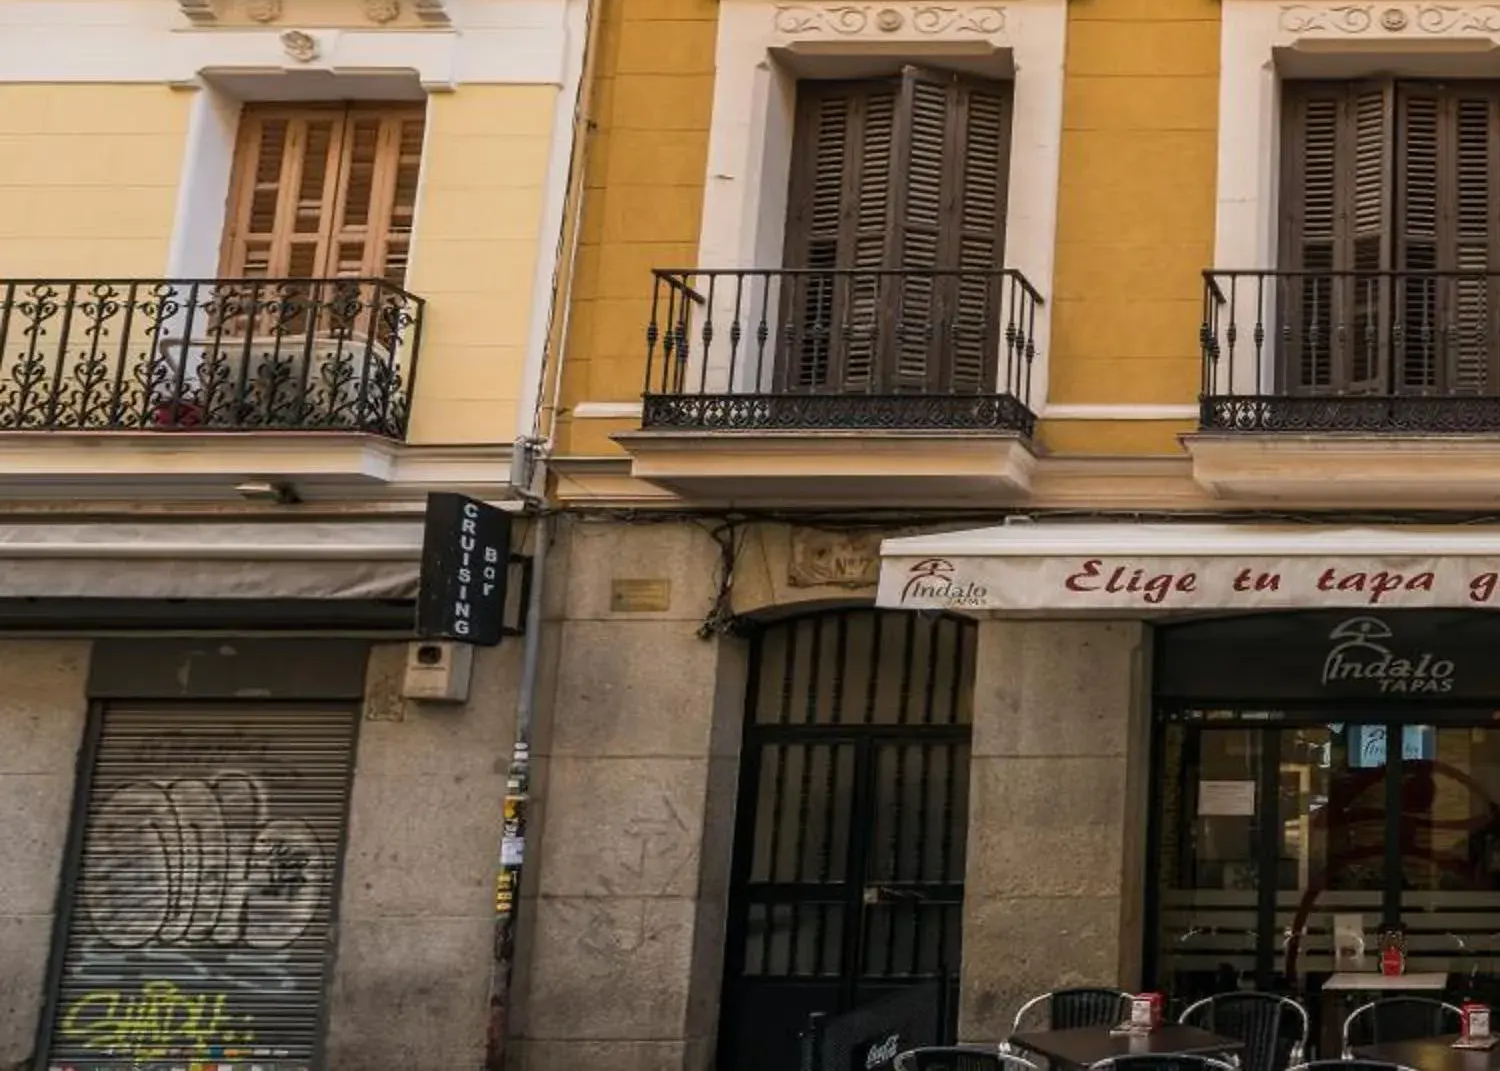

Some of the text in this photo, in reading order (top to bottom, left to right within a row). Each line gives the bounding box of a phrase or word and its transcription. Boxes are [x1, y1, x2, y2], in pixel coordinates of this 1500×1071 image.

[454, 502, 479, 634] CRUISING
[483, 545, 498, 596] Bar
[1065, 559, 1197, 603] Elige
[1232, 567, 1281, 592] tu
[1316, 566, 1435, 604] tapa
[911, 581, 987, 598] Indalo
[1328, 653, 1456, 679] Indalo
[1378, 679, 1454, 693] TAPAS
